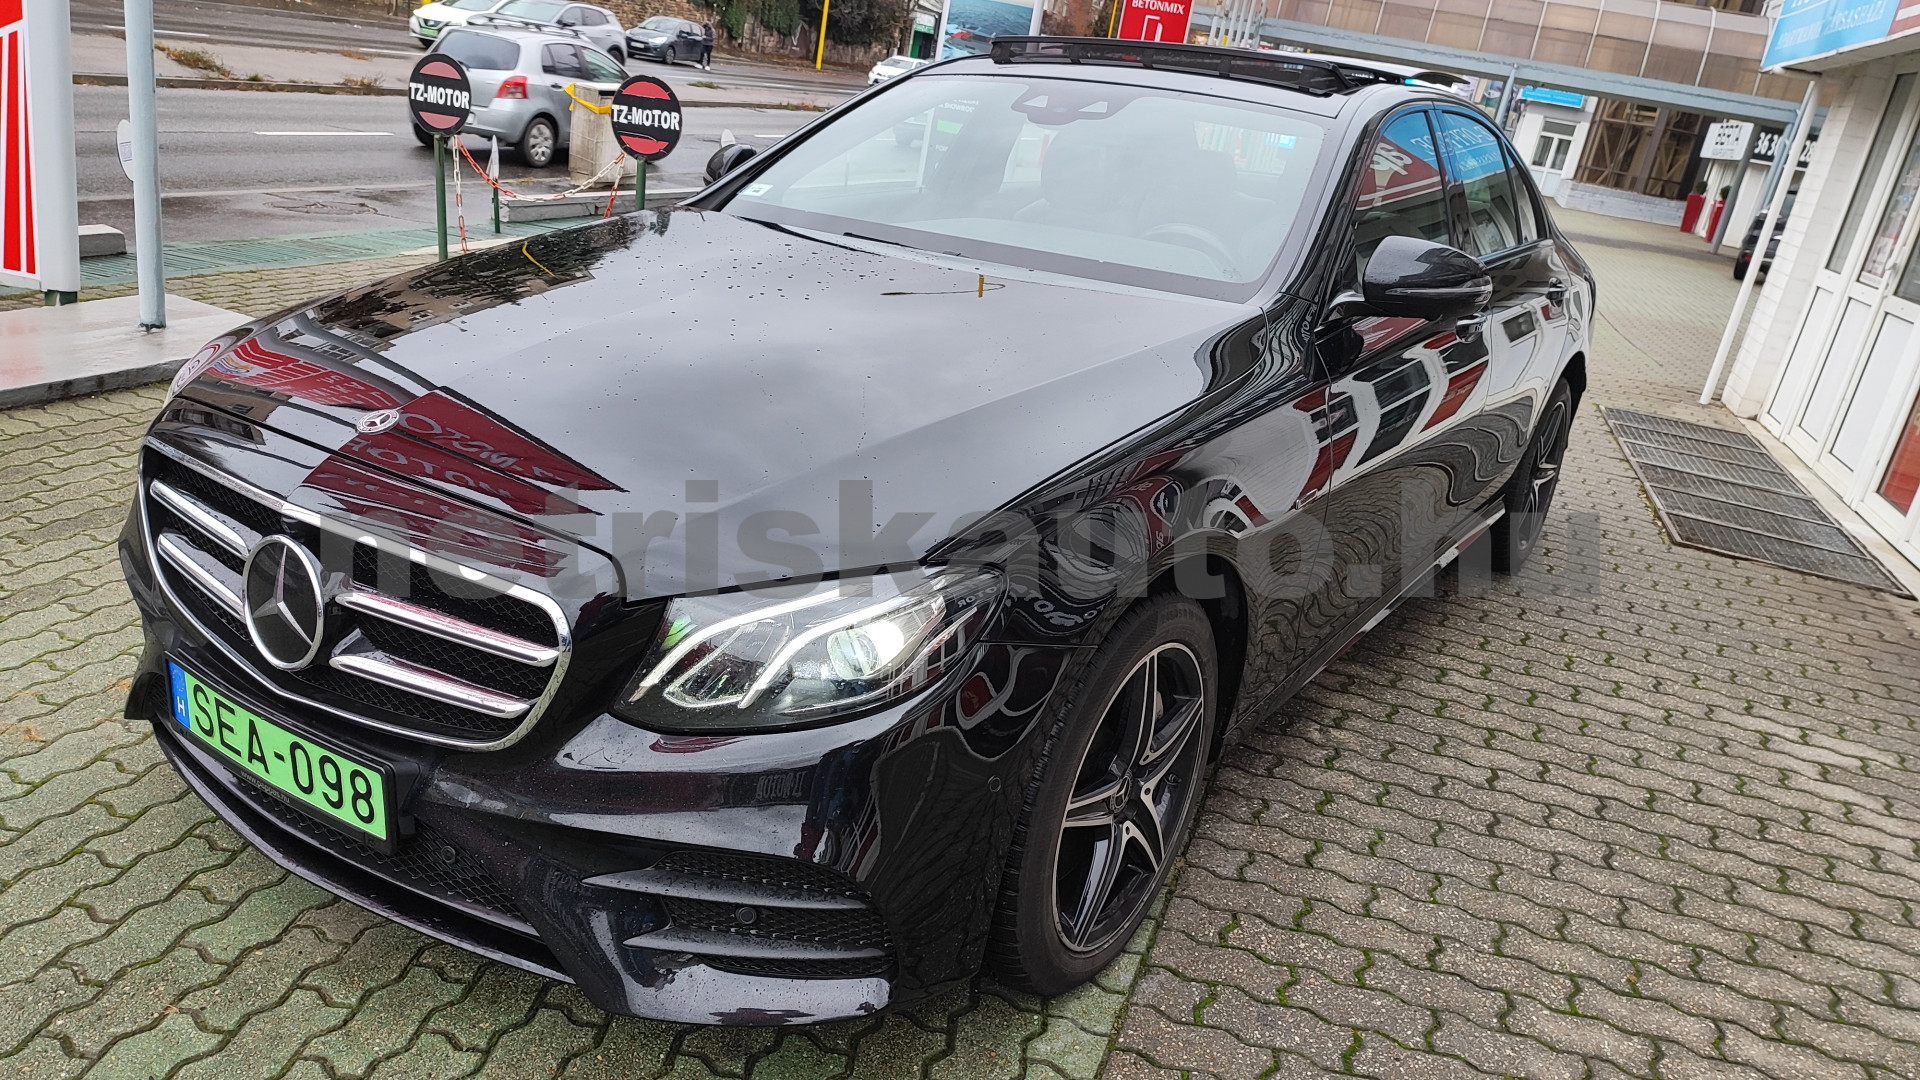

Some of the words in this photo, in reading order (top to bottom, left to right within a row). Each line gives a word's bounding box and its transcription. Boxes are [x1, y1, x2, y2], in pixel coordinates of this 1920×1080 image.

[1131, 0, 1185, 15] BETONMIX
[409, 82, 470, 109] TZ-MOTOR
[611, 104, 680, 131] TZ-MOTOR
[177, 696, 185, 717] H
[193, 684, 375, 825] SEA-098
